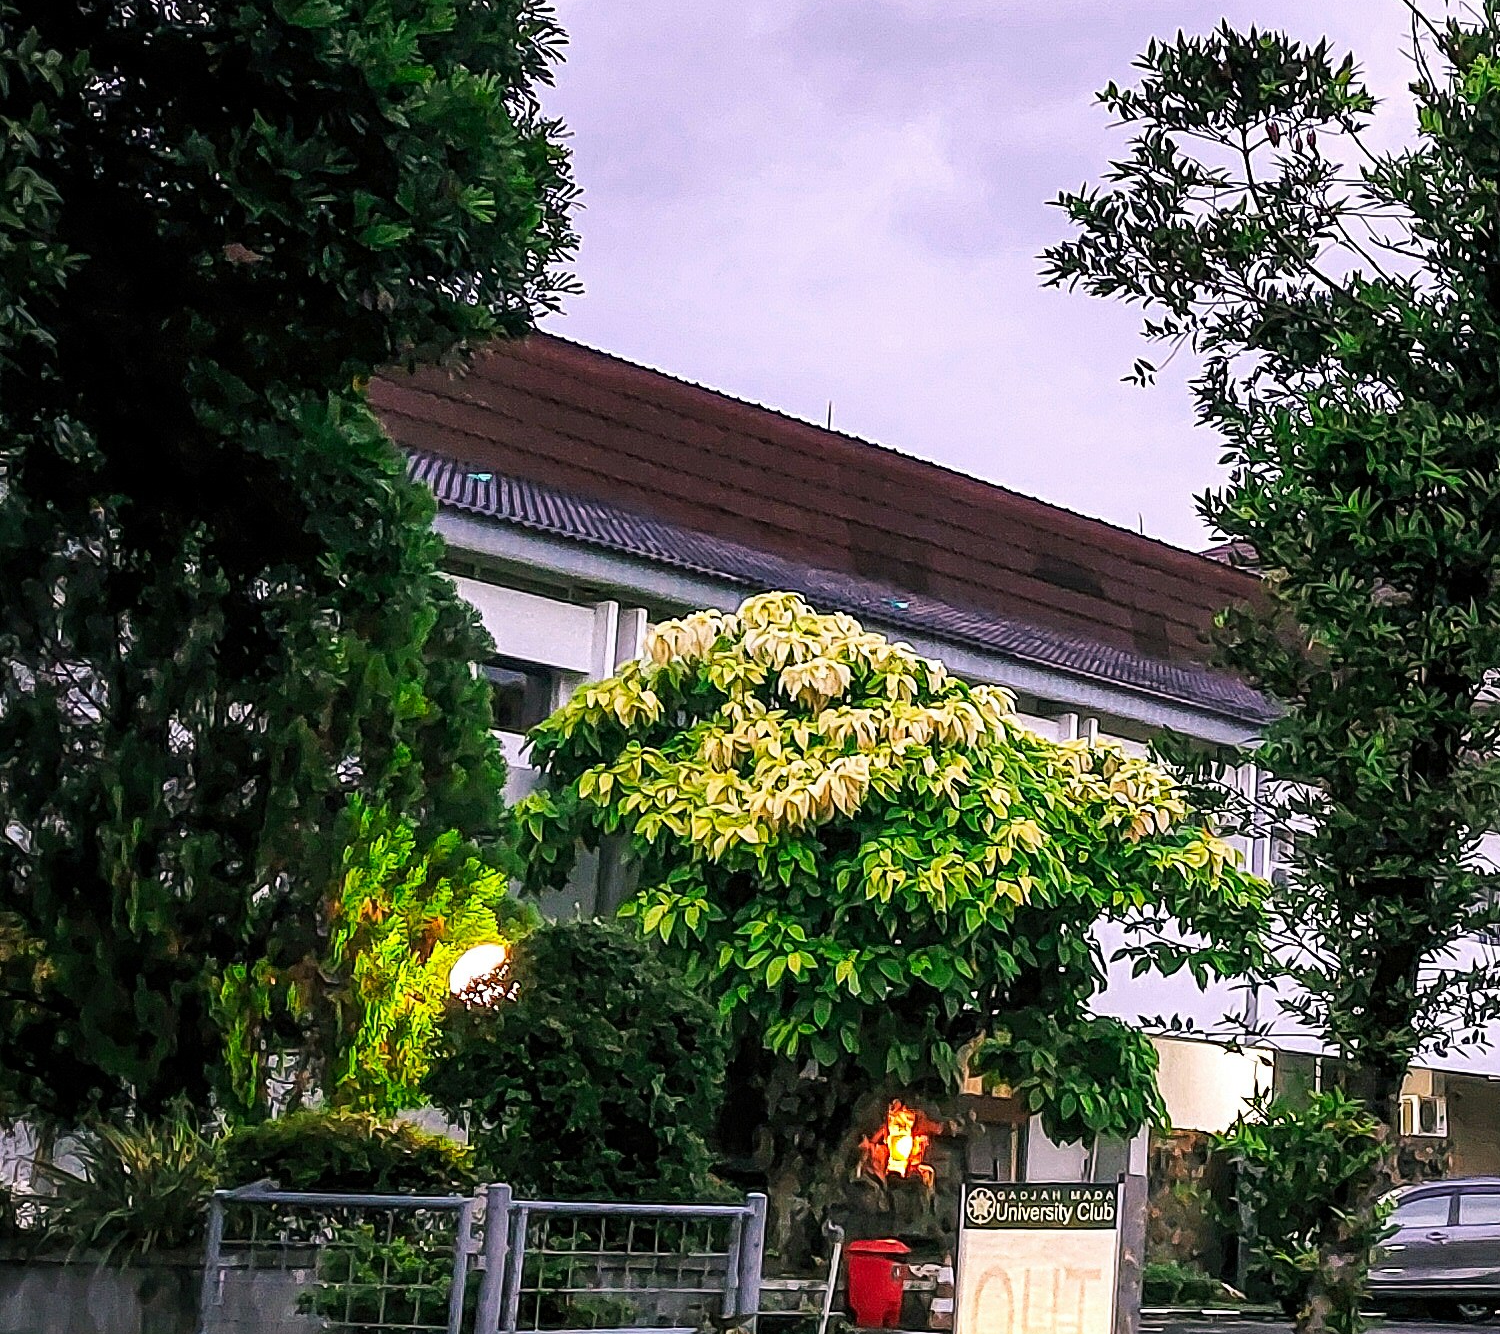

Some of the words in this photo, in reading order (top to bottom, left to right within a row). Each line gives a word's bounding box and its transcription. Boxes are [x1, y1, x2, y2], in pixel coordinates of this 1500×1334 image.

[997, 1190, 1061, 1201] GADJAH
[1070, 1190, 1114, 1201] MADA
[996, 1201, 1074, 1225] University
[1077, 1201, 1115, 1222] Club
